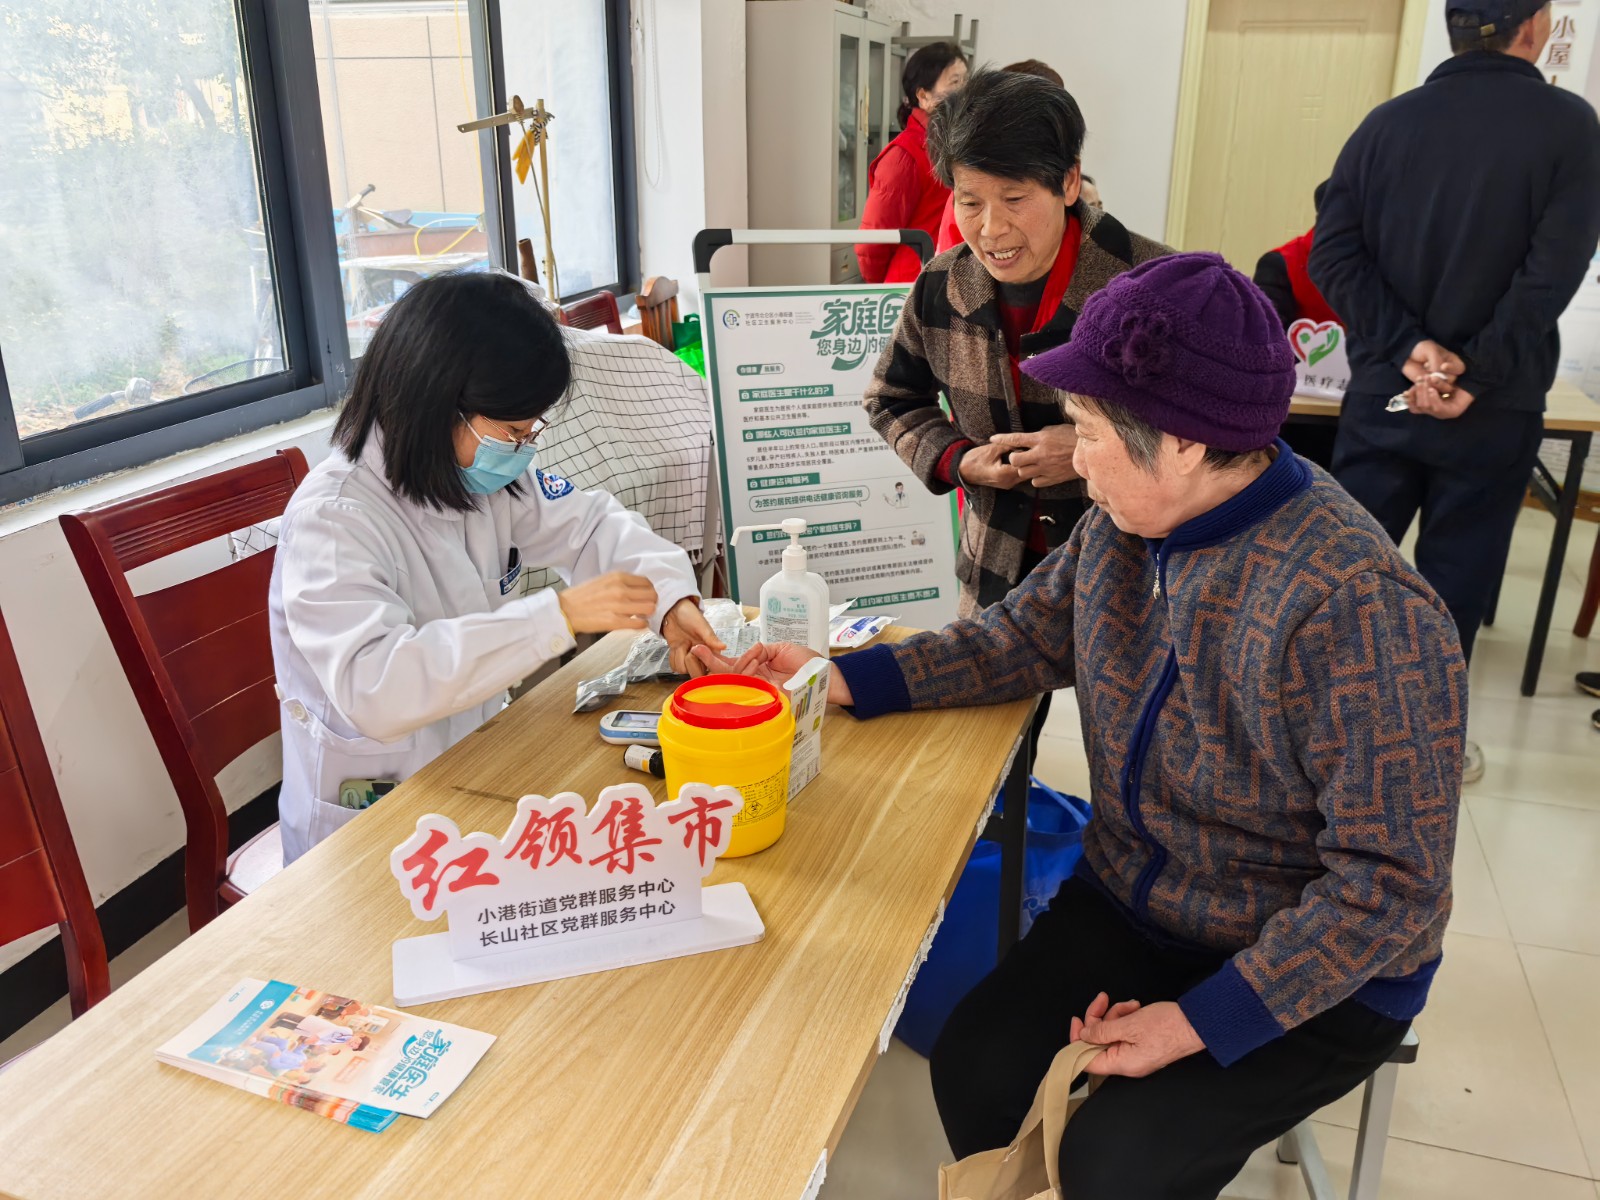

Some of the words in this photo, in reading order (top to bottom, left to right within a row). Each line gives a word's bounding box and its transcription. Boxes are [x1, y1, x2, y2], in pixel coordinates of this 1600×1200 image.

[1546, 15, 1575, 85] 小屋
[810, 293, 907, 339] 家庭医
[755, 490, 864, 508] 为签约居民提供电话健康咨询服务
[760, 476, 810, 487] 健康咨询服务
[402, 796, 734, 911] 红领集市
[478, 877, 676, 925] 小港街道党群服务中心
[479, 900, 677, 947] 长山社区党群服务中心
[382, 1028, 452, 1101] 家庭医生
